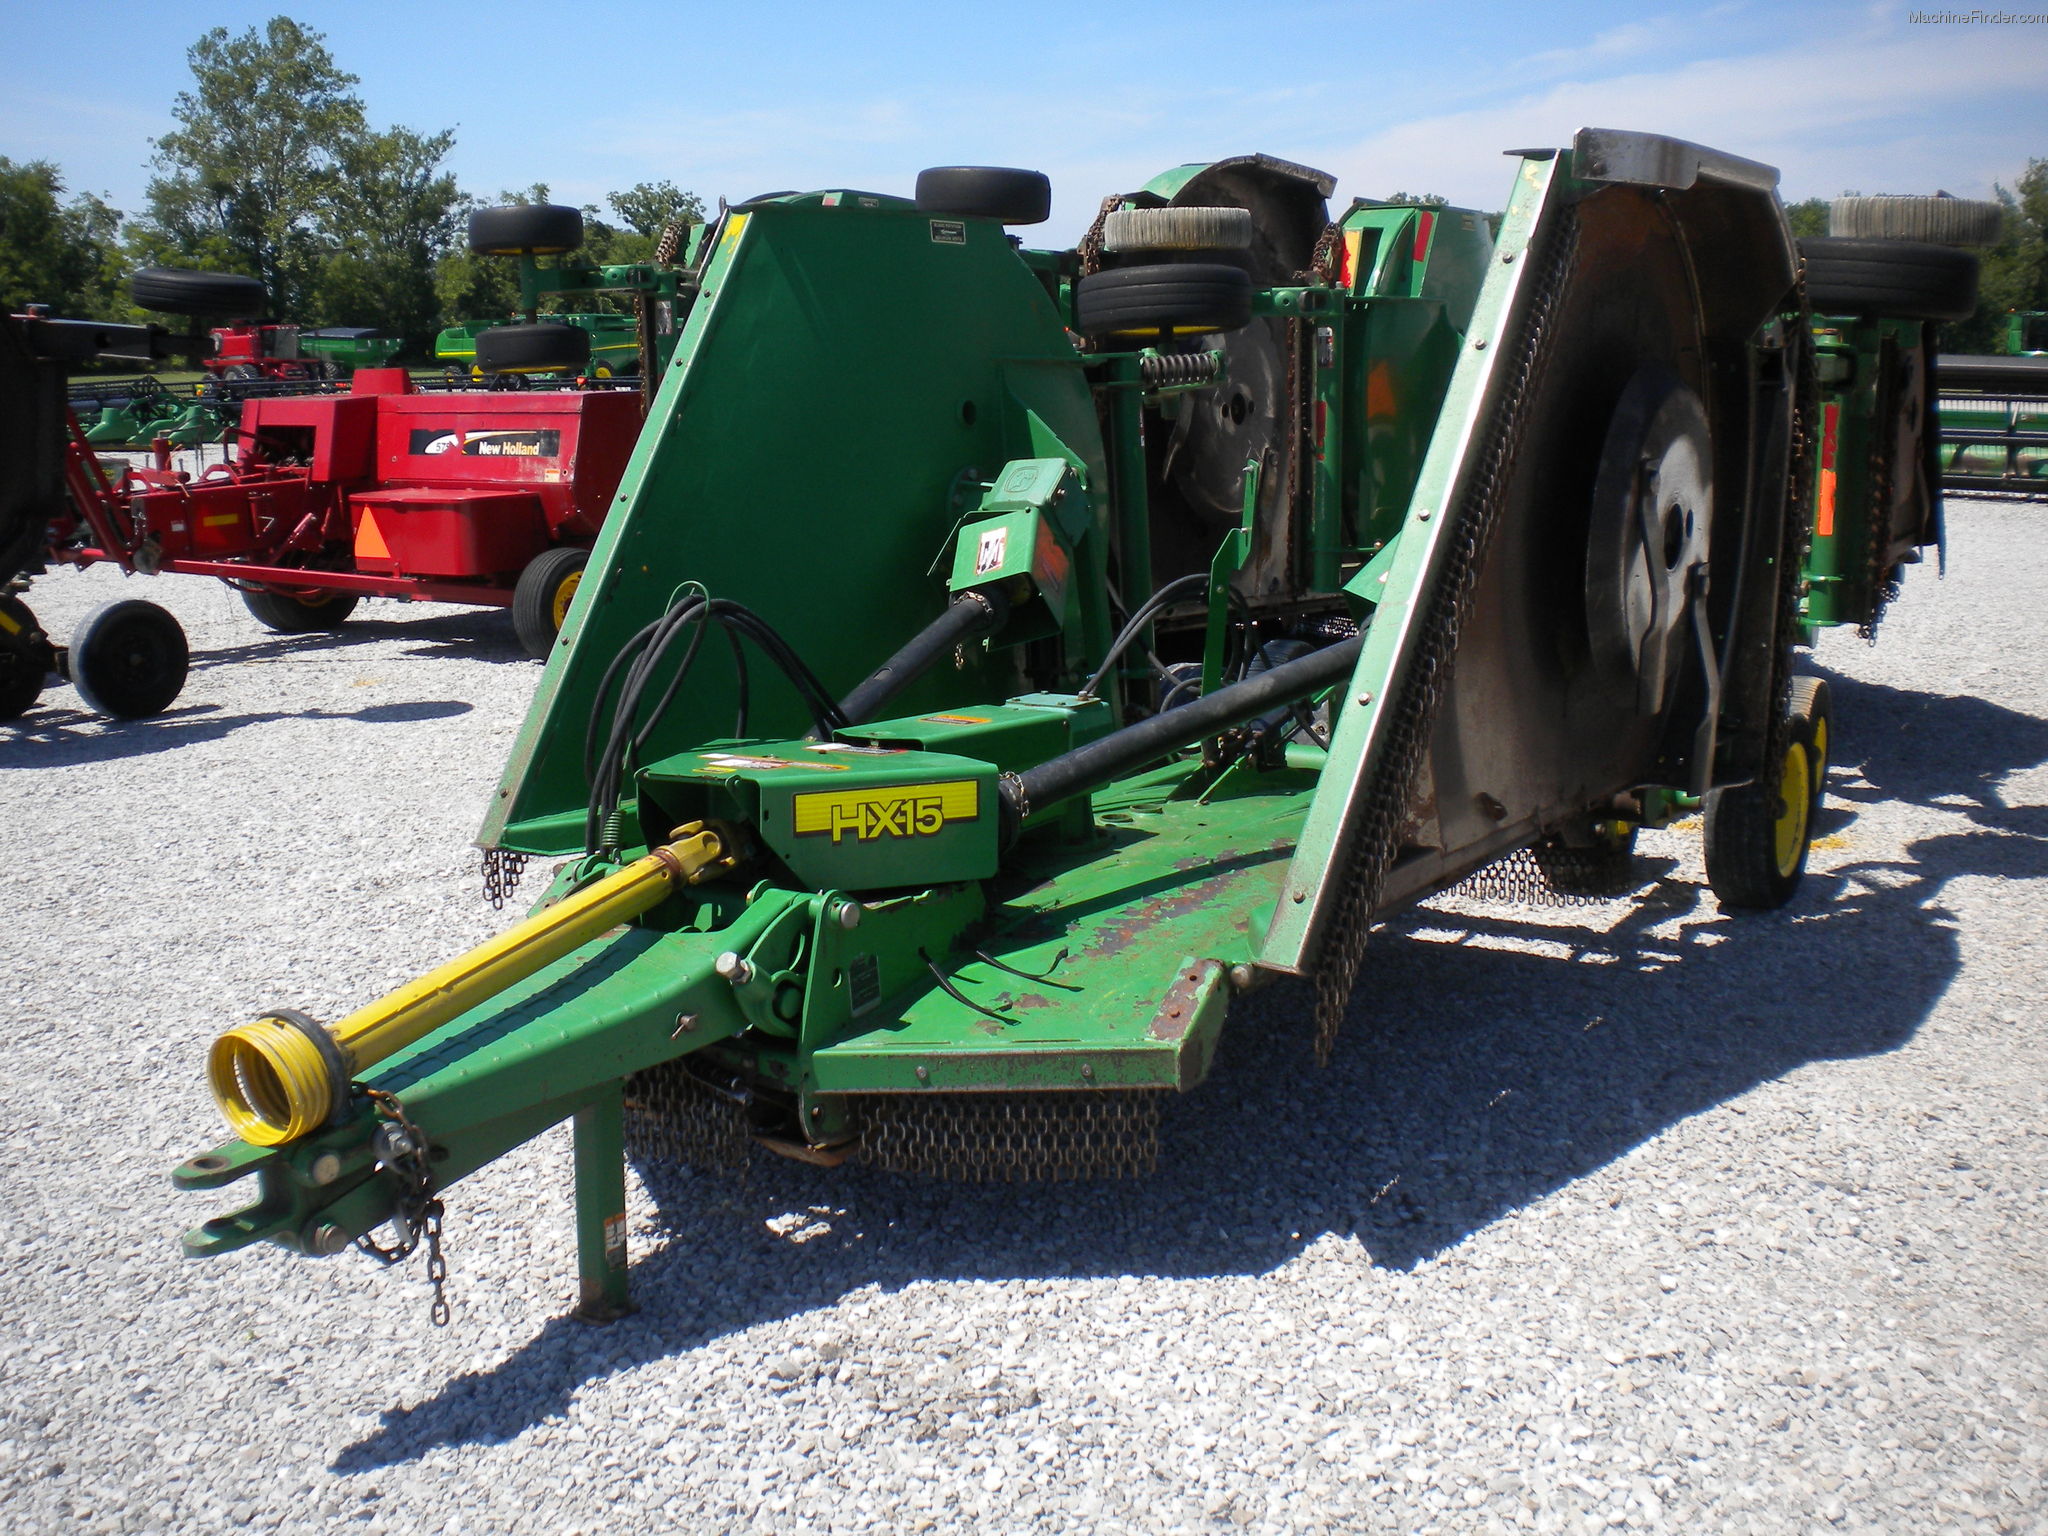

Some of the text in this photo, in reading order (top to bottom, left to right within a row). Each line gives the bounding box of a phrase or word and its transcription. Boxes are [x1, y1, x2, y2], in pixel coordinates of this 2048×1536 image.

[479, 441, 540, 456] New Holland
[832, 796, 944, 843] HX15
